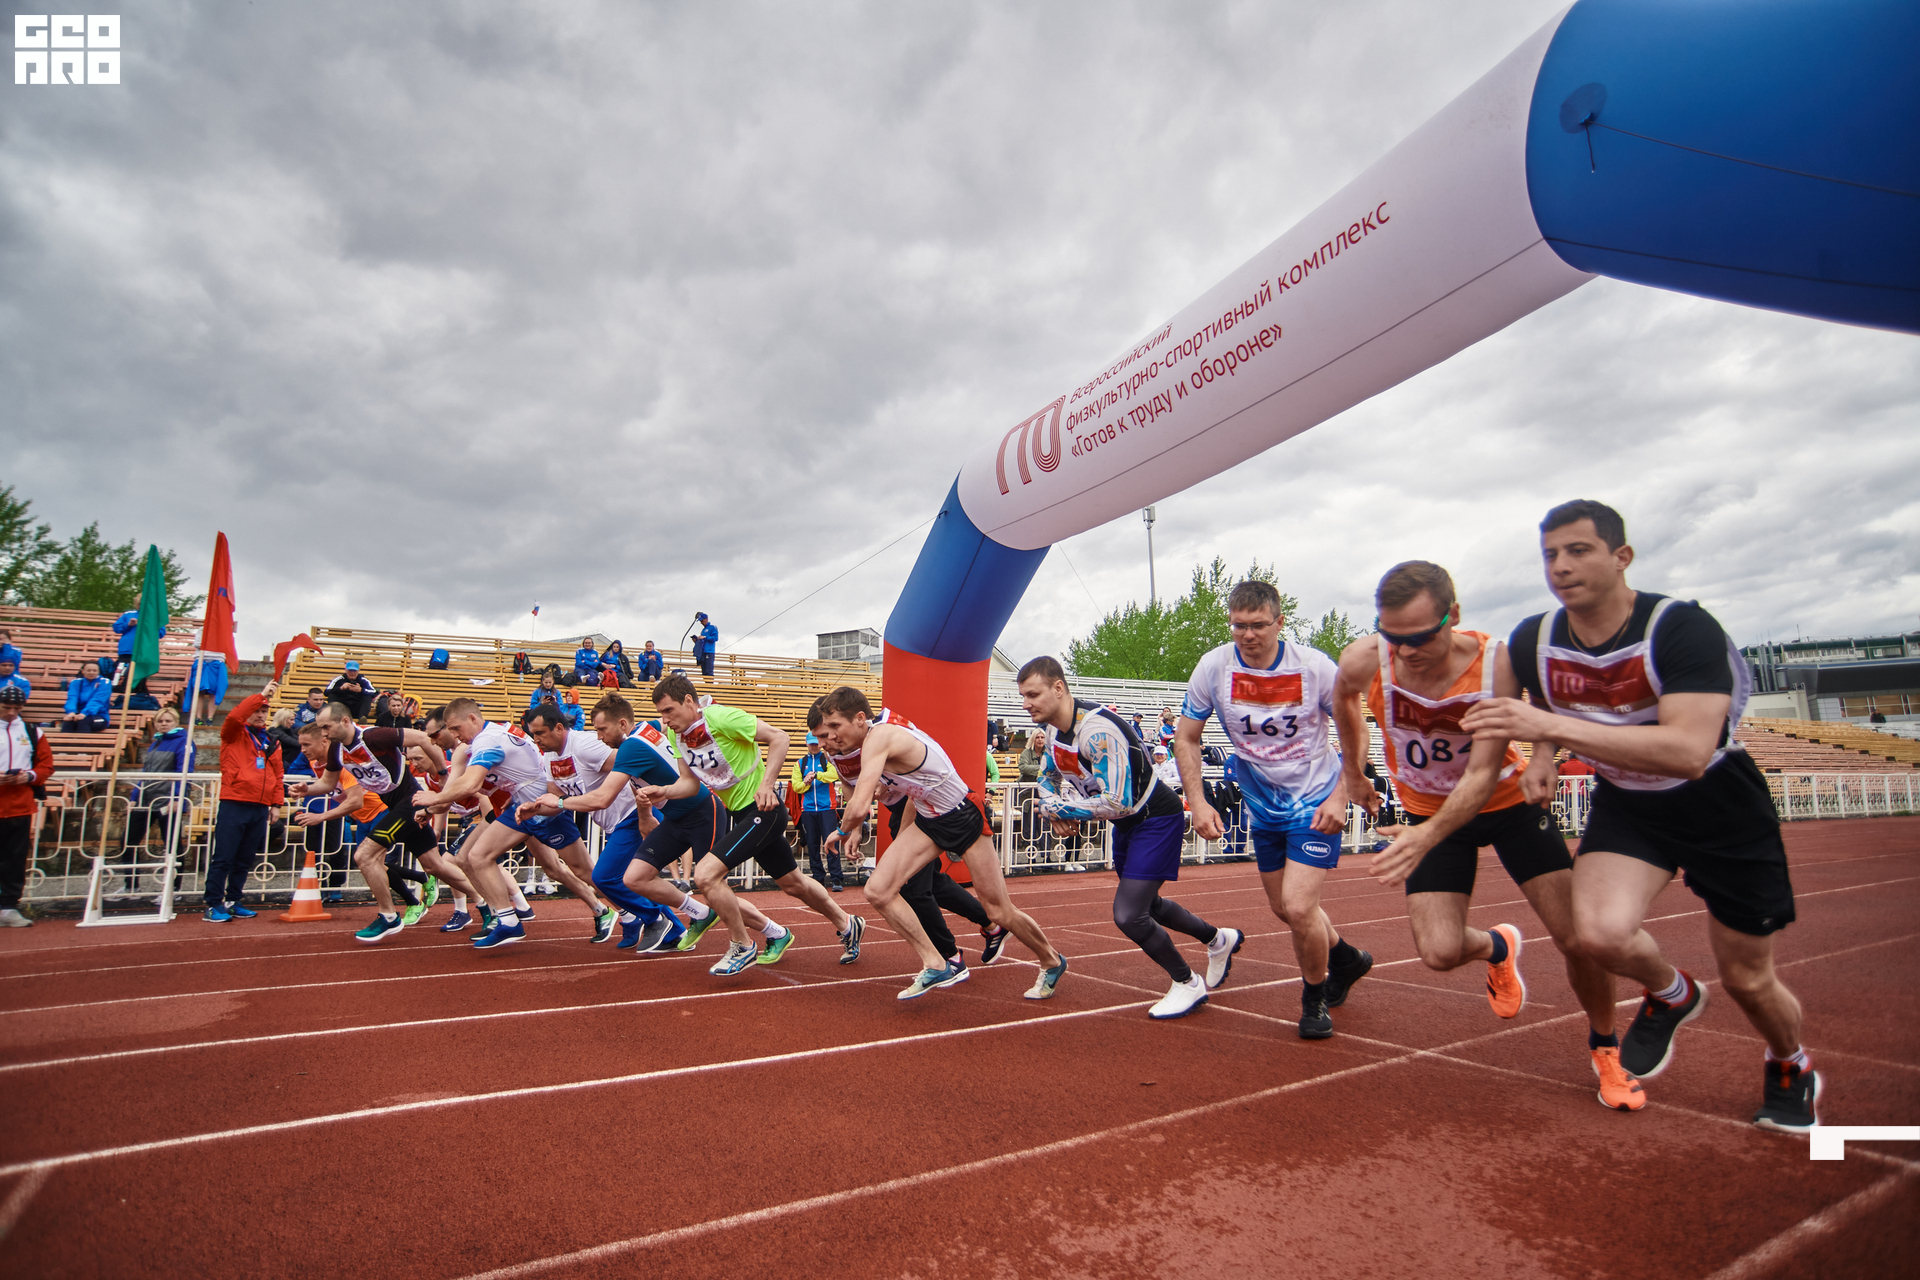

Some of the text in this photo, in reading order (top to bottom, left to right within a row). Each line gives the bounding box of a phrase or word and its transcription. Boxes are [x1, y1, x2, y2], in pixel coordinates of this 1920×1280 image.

[1066, 201, 1390, 434] физкультурно-спортивный комплекс
[1070, 322, 1173, 404] Всероссийский
[1071, 323, 1282, 457] «Готов к труду и обороне»
[1240, 714, 1299, 738] 163
